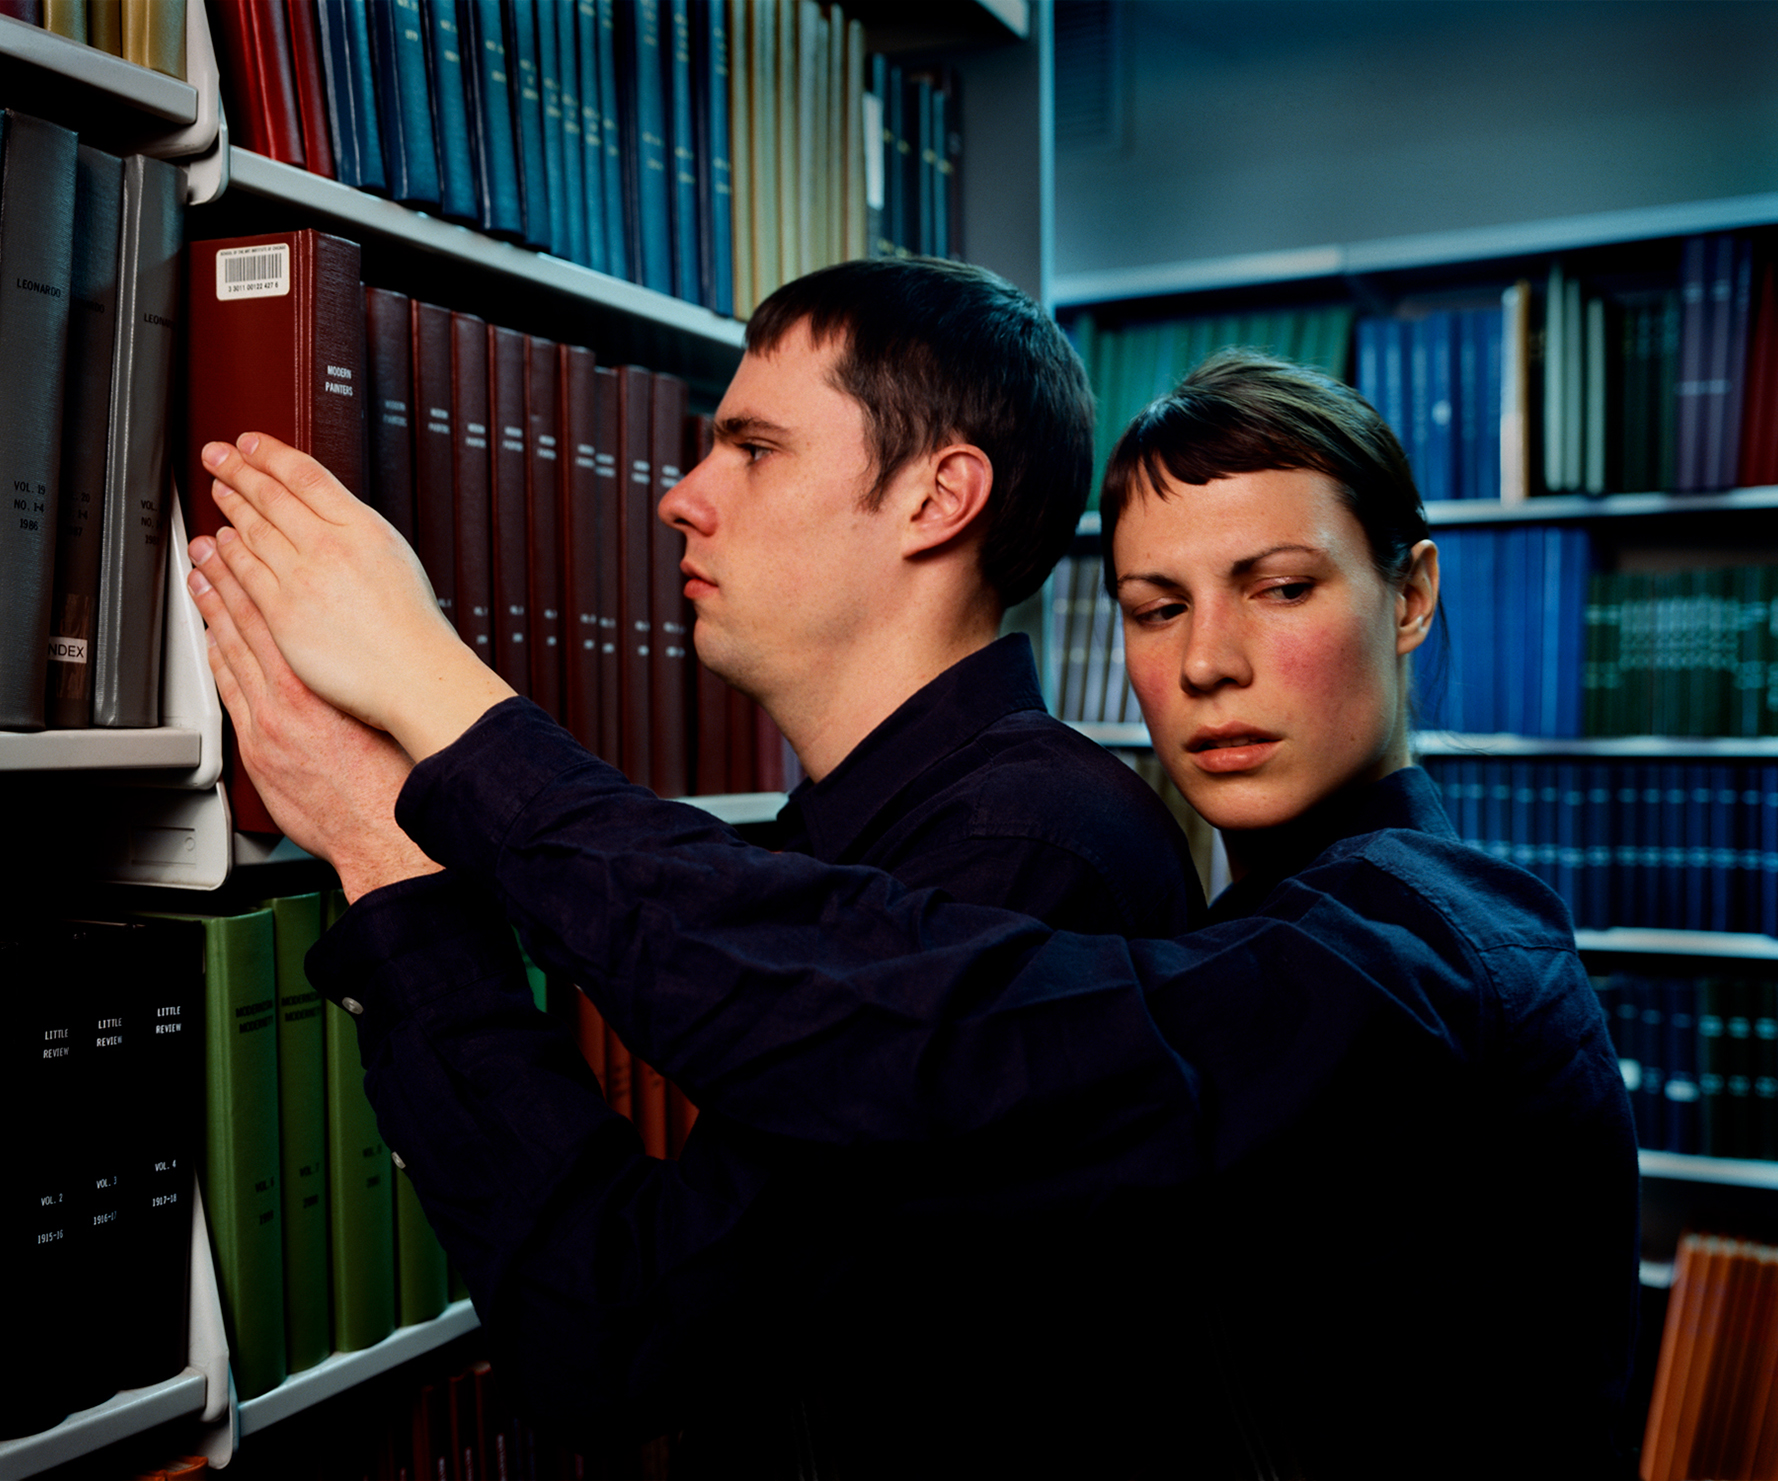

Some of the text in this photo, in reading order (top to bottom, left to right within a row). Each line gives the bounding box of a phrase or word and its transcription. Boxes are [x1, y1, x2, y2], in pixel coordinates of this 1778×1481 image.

[16, 278, 61, 298] LEONARDO
[327, 364, 352, 380] MODERN
[325, 381, 354, 397] PAINTERS
[13, 480, 46, 496] VOL. 19
[13, 498, 45, 513] NO. 1-4
[140, 499, 157, 512] VOL.
[19, 518, 39, 531] 1986
[140, 516, 154, 529] NO.
[47, 643, 85, 659] NDEX
[157, 1005, 181, 1017] LITTLE
[98, 1017, 123, 1029] LITTLE
[155, 1023, 182, 1034] REVIEW
[44, 1028, 69, 1040] LITTLE
[96, 1035, 123, 1047] REVIEW
[43, 1046, 70, 1059] REVIEW
[154, 1159, 177, 1172] VOL. 4
[96, 1175, 118, 1189] VOL. 3
[40, 1193, 63, 1206] VOL. 2
[152, 1193, 178, 1208] 1917-18
[93, 1210, 118, 1226] 1916-17
[37, 1229, 64, 1245] 1915-16
